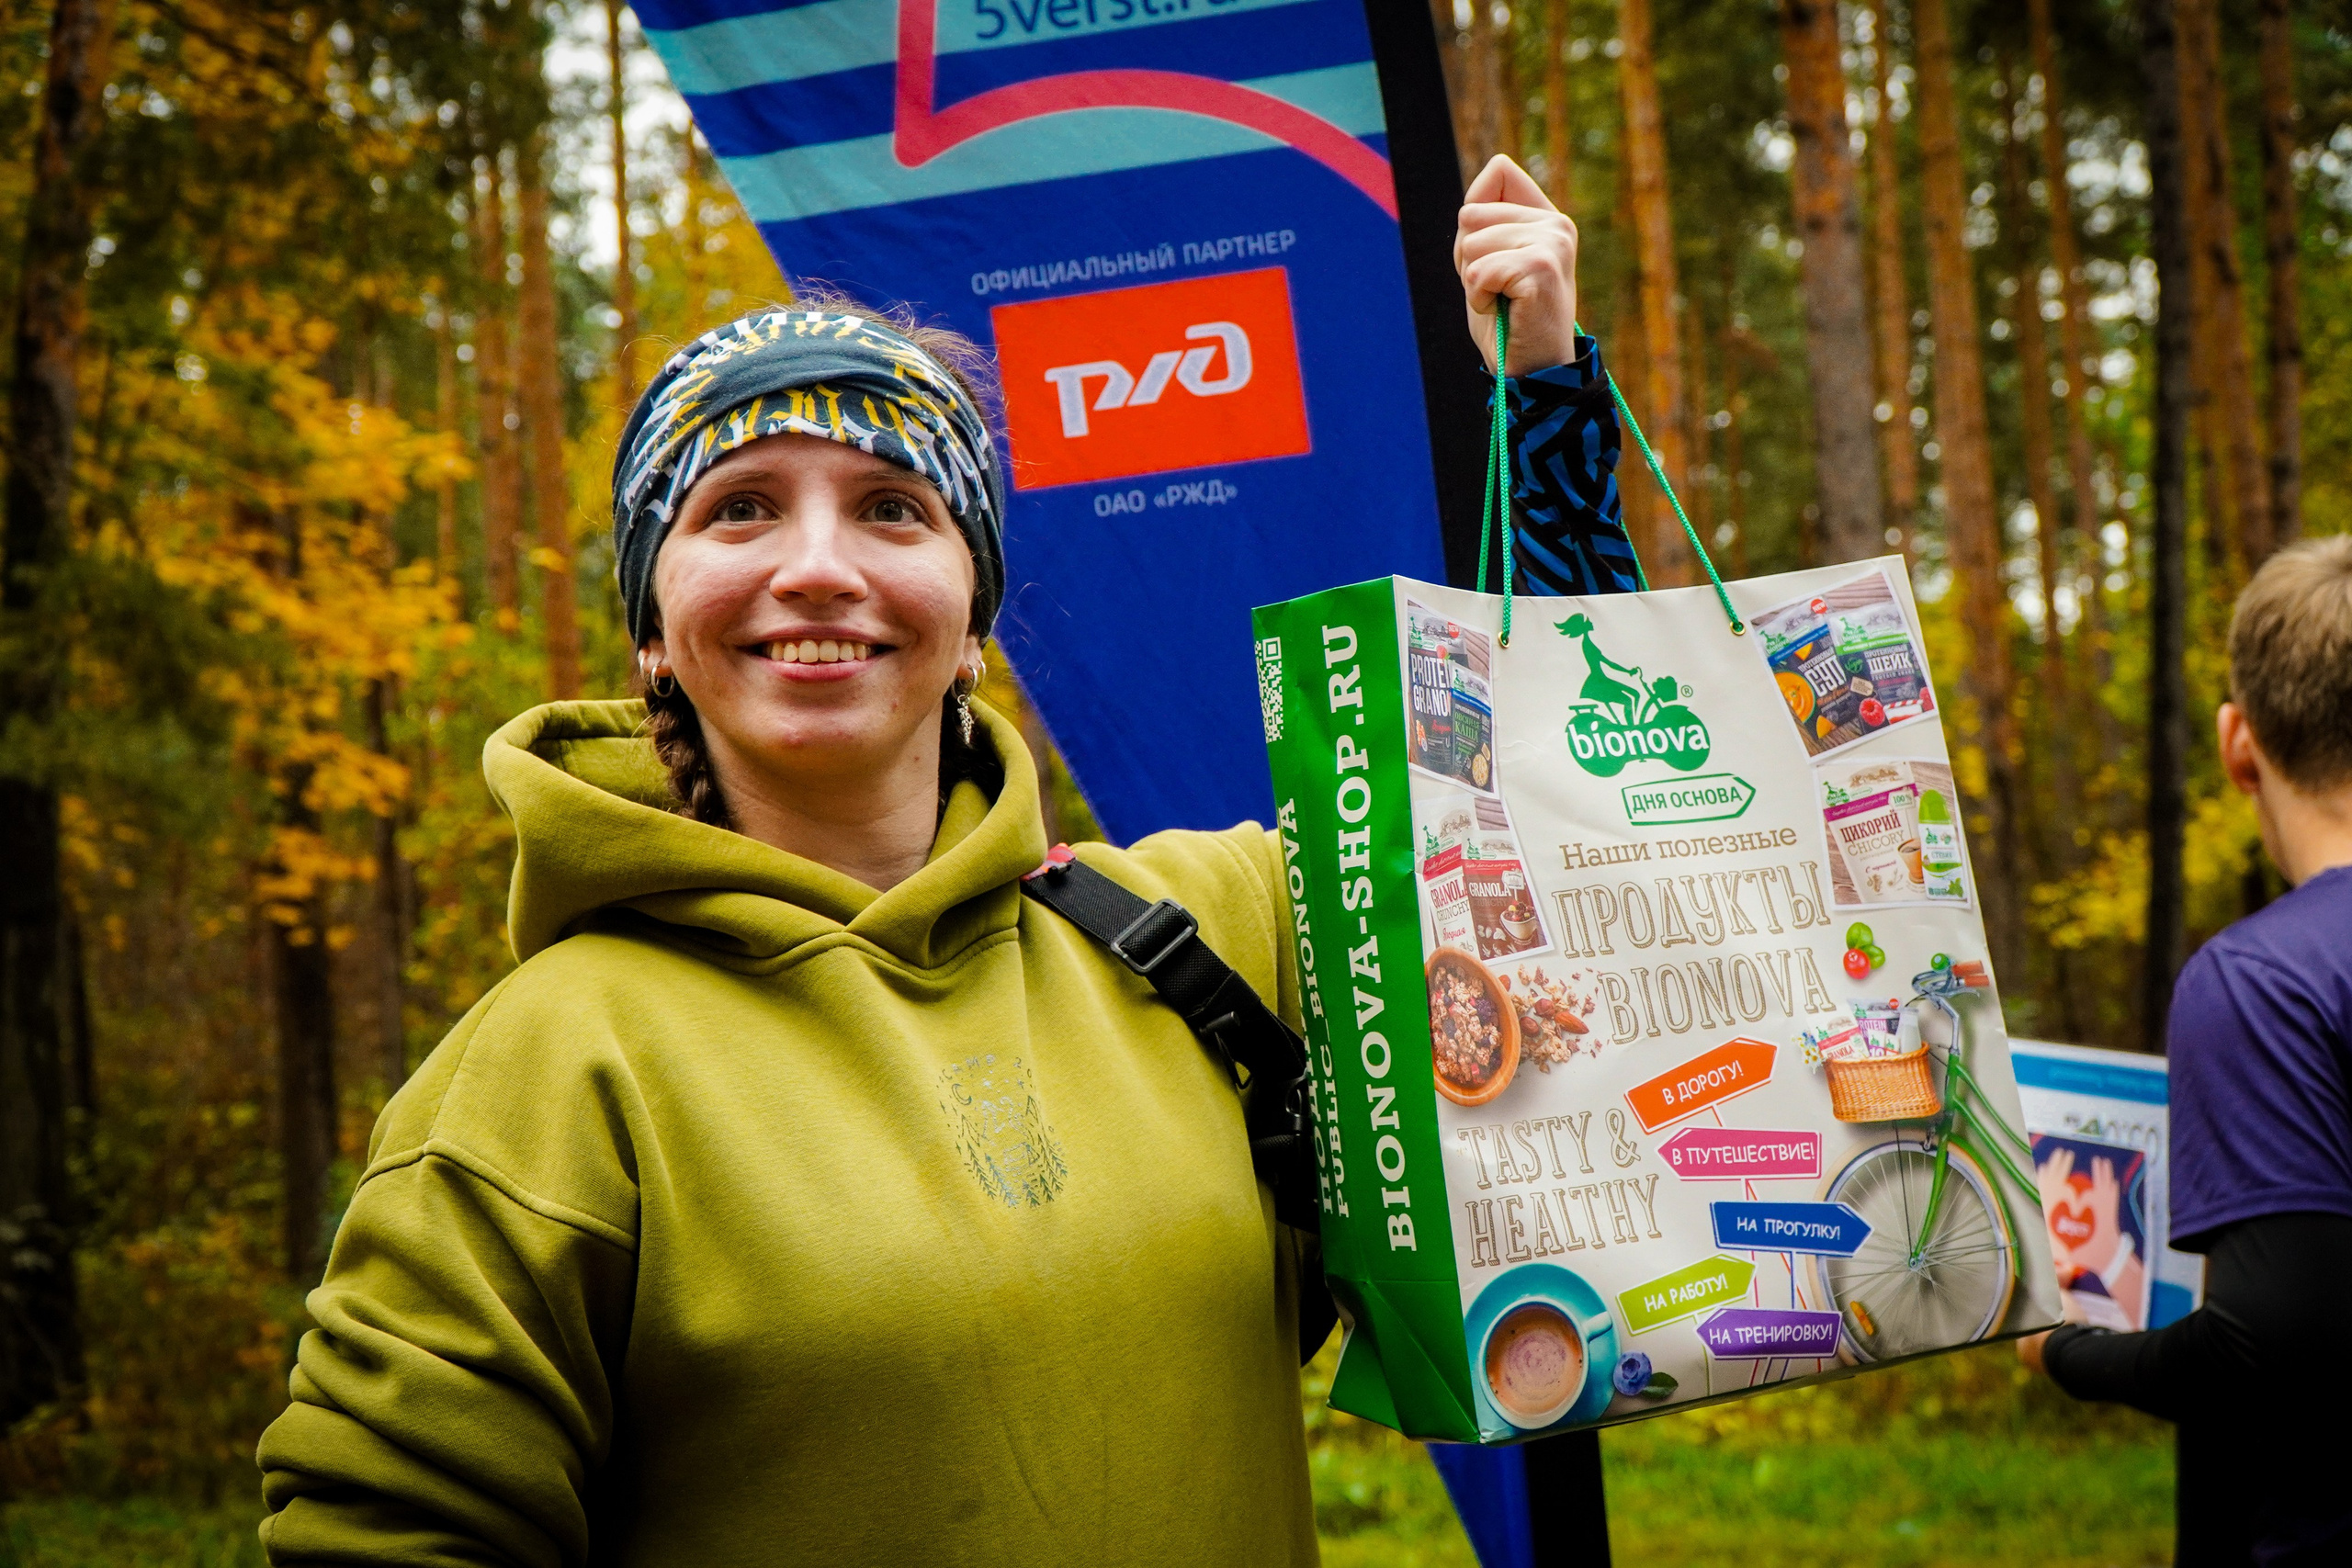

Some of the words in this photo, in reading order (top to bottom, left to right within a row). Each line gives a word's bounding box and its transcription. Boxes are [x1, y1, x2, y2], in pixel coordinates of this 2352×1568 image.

[971, 242, 1175, 296] ОФИЦИАЛЬНЫЙ
[1182, 229, 1297, 266] ПАРТНЕР
[1093, 490, 1146, 517] ОАО
[1153, 479, 1238, 511] «РЖД»
[1410, 653, 1453, 689] PROTEI
[1804, 655, 1847, 697] СУП
[1866, 651, 1913, 675] ШЕЙК
[1567, 720, 1710, 760] bionova
[1632, 793, 1668, 814] ДНЯ
[1670, 786, 1743, 807] ОСНОВА
[1839, 809, 1902, 847] ЦИКОРИЙ
[1848, 829, 1905, 856] CHICORY
[1559, 842, 1652, 870] Наши
[1656, 828, 1799, 858] полезные
[1468, 882, 1512, 897] GRANOLA
[1551, 861, 1831, 958] ПРОДУКТЫ
[1321, 625, 1418, 1253] BIONOVA-SHOP.RU
[1596, 947, 1837, 1044] BIONOVA
[1661, 1089, 1675, 1105] В
[1678, 1059, 1744, 1101] ДОРОГУ!
[1457, 1111, 1594, 1190] TASTY
[1605, 1108, 1642, 1168] &
[1672, 1149, 1683, 1166] В
[1686, 1141, 1815, 1165] ПУТЕШЕСТВИЕ!
[1464, 1173, 1662, 1269] HEALTHY
[1736, 1217, 1758, 1234] НА
[1763, 1217, 1841, 1241] ПРОГУЛКУ!
[1644, 1292, 1668, 1313] НА
[1670, 1273, 1729, 1303] РАБОТУ!
[1709, 1326, 1733, 1346] НА
[1736, 1322, 1833, 1346] ТРЕНИРОВКУ!
